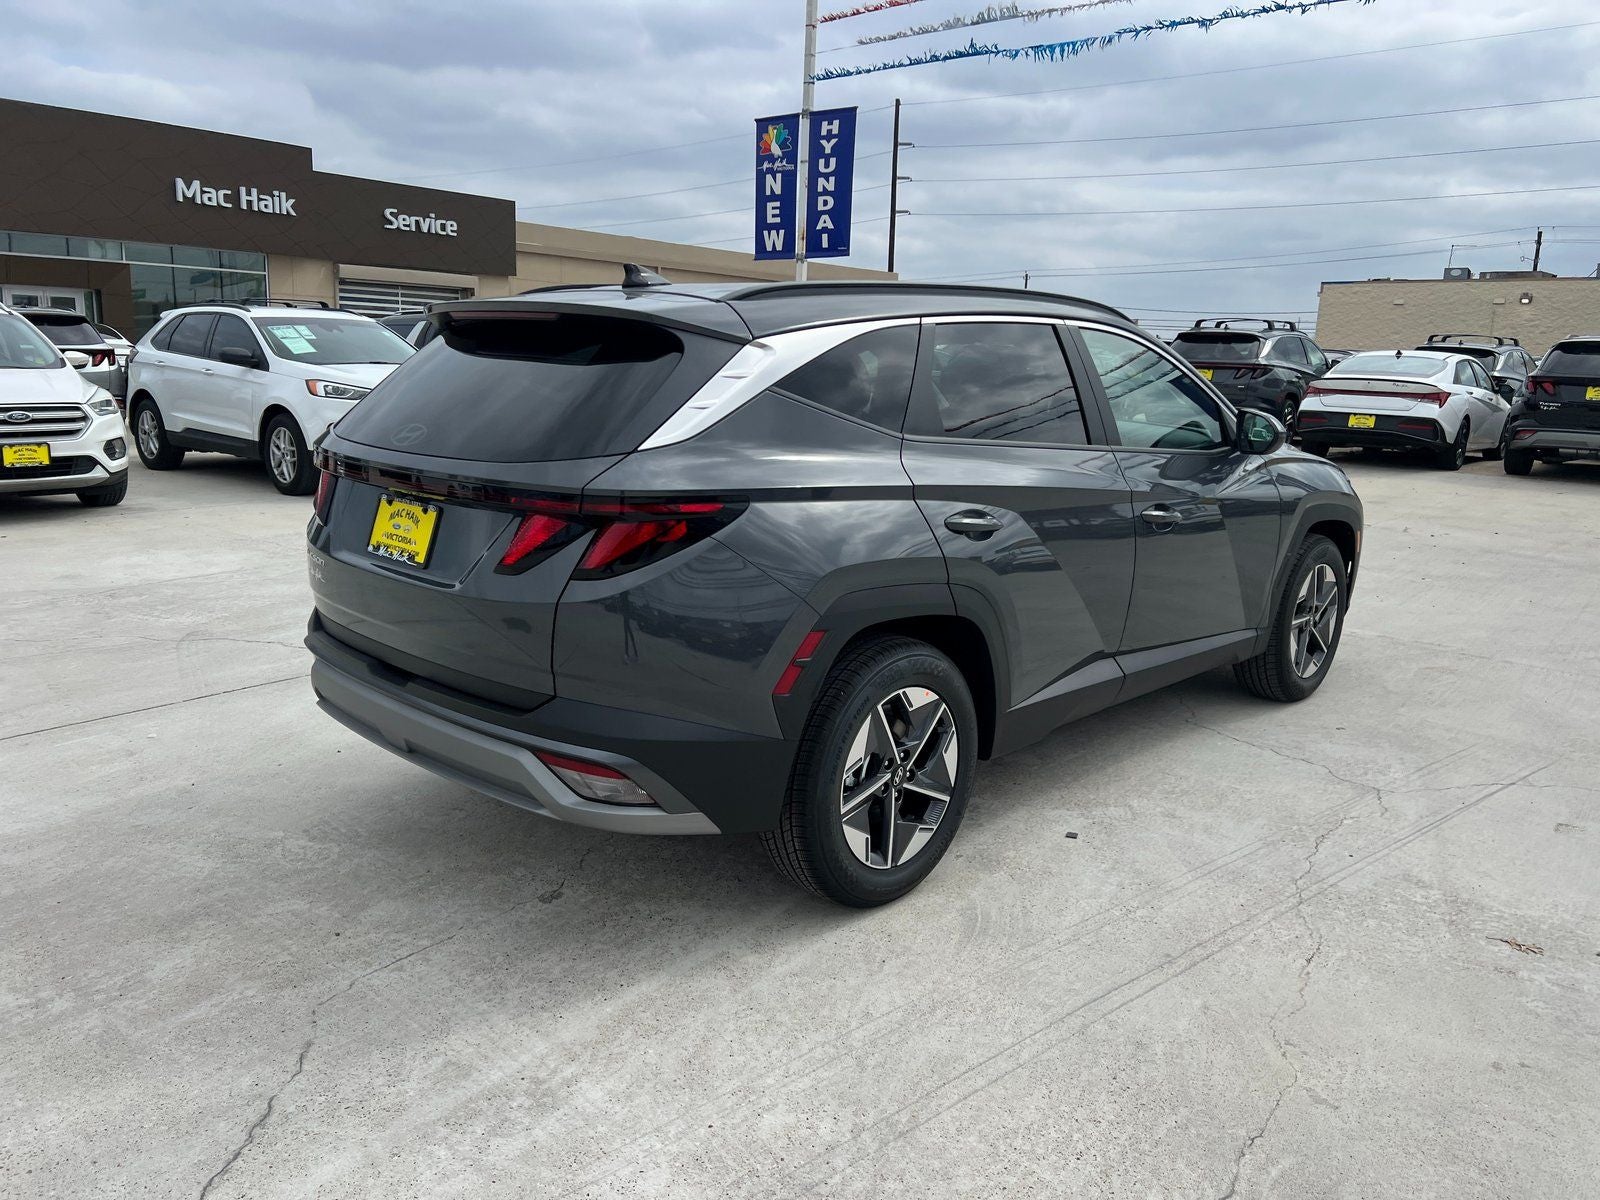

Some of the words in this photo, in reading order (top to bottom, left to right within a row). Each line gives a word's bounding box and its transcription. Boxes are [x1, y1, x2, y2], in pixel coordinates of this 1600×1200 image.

[174, 177, 233, 209] Mac
[239, 186, 297, 216] Haik
[816, 119, 840, 249] HYUNDAI
[383, 208, 458, 237] Service
[763, 172, 785, 252] NEW
[387, 508, 405, 522] MAC
[405, 509, 421, 530] HAIK
[386, 532, 414, 546] VICTORIA
